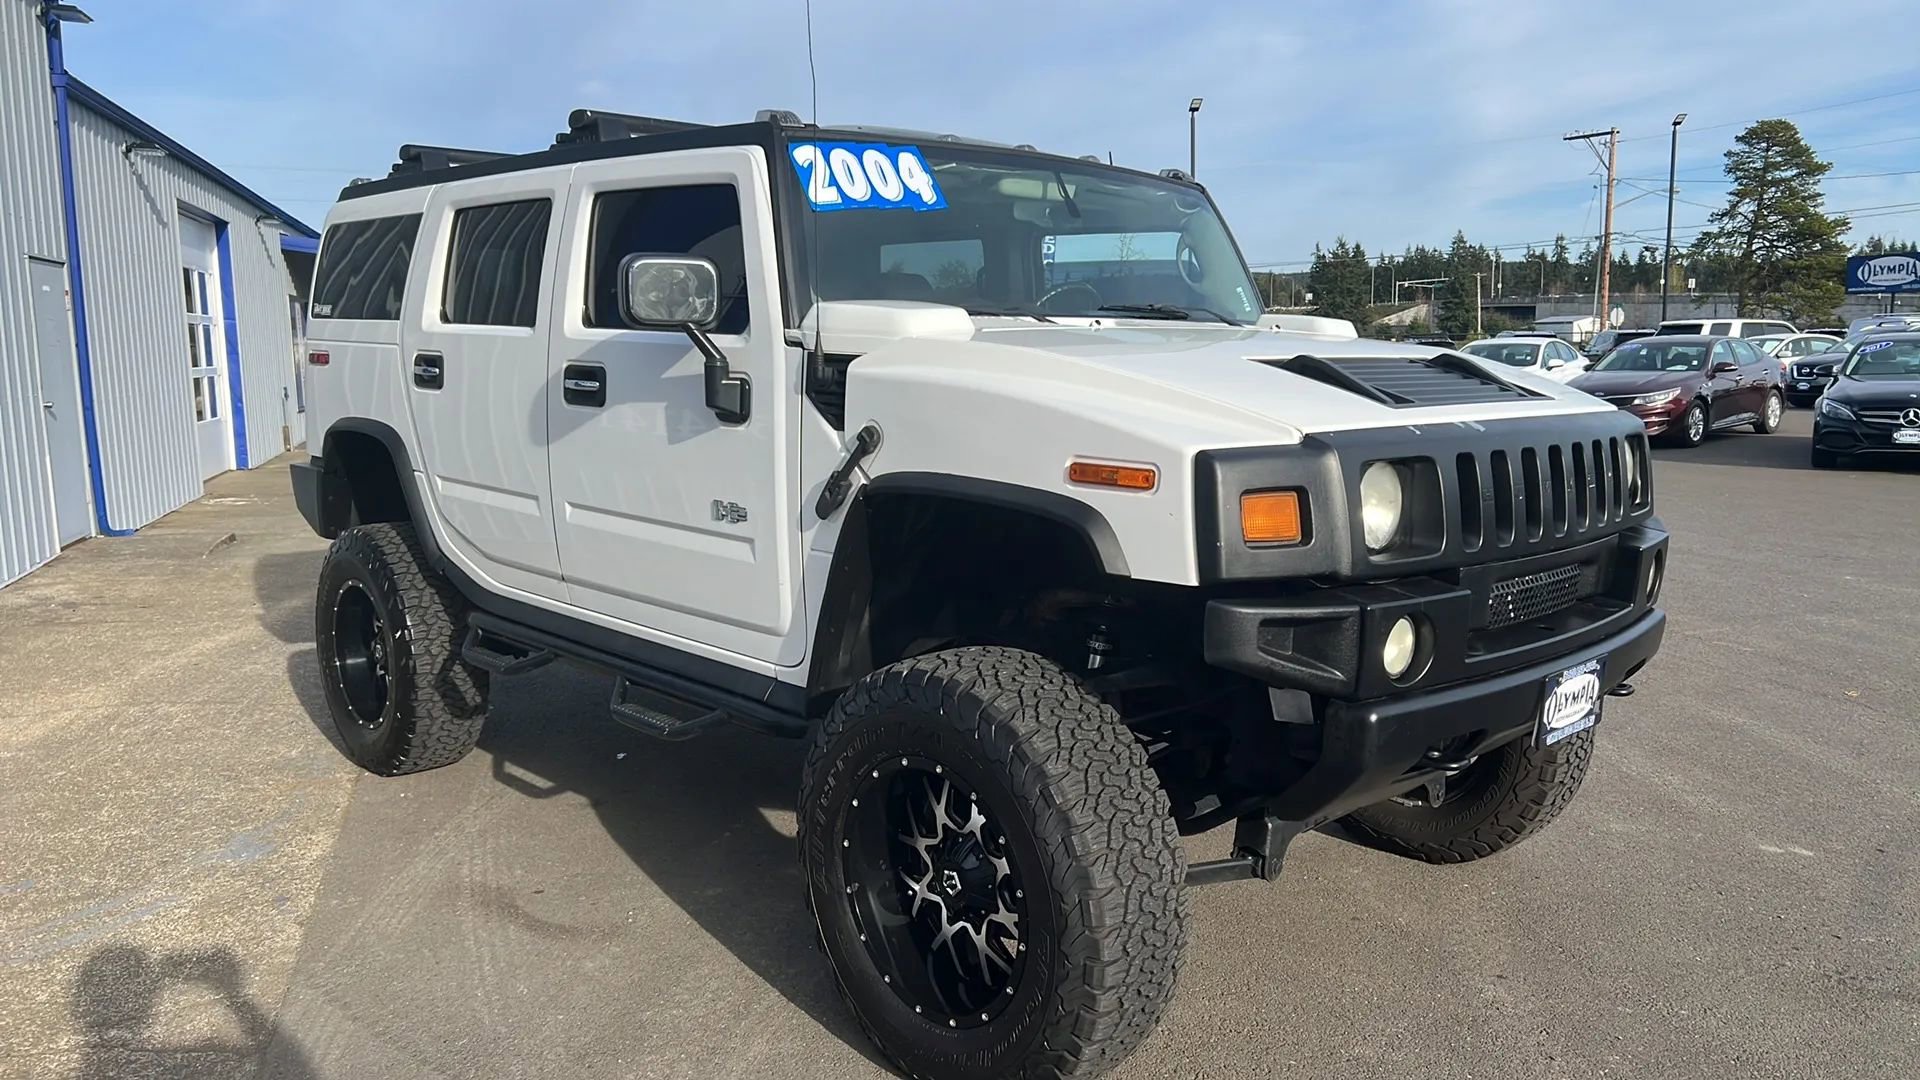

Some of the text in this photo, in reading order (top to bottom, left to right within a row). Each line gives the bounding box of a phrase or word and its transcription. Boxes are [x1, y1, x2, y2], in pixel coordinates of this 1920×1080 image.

[792, 145, 937, 205] 2004
[1861, 259, 1919, 283] OLYMPIA
[1546, 677, 1597, 725] OLYMPIA
